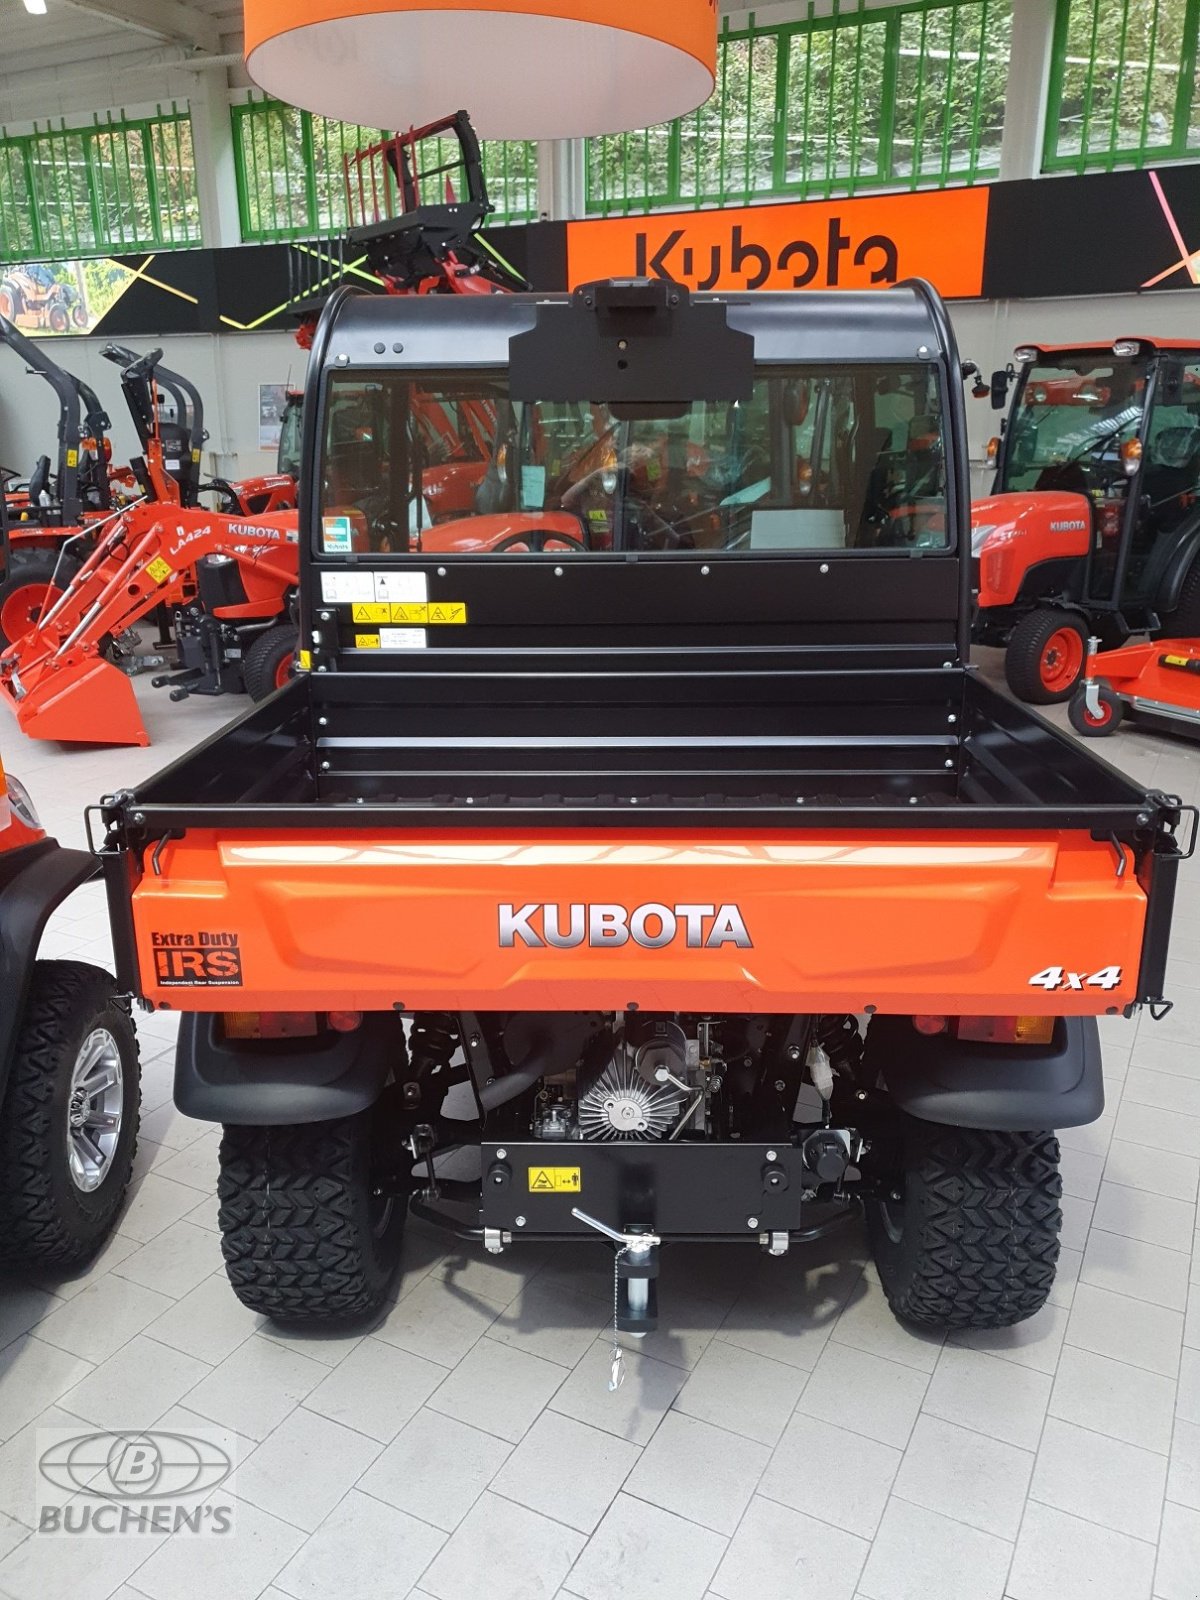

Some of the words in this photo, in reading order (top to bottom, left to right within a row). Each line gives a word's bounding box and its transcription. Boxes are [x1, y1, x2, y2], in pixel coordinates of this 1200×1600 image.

[636, 217, 898, 291] Kubota
[228, 523, 281, 539] KUBOTA
[1049, 520, 1086, 532] KUBOTA
[169, 525, 212, 555] LA424
[498, 902, 754, 949] KUBOTA
[151, 932, 195, 947] Extra
[198, 932, 238, 947] Duty
[156, 951, 239, 977] IRS
[1027, 965, 1123, 991] 4x4
